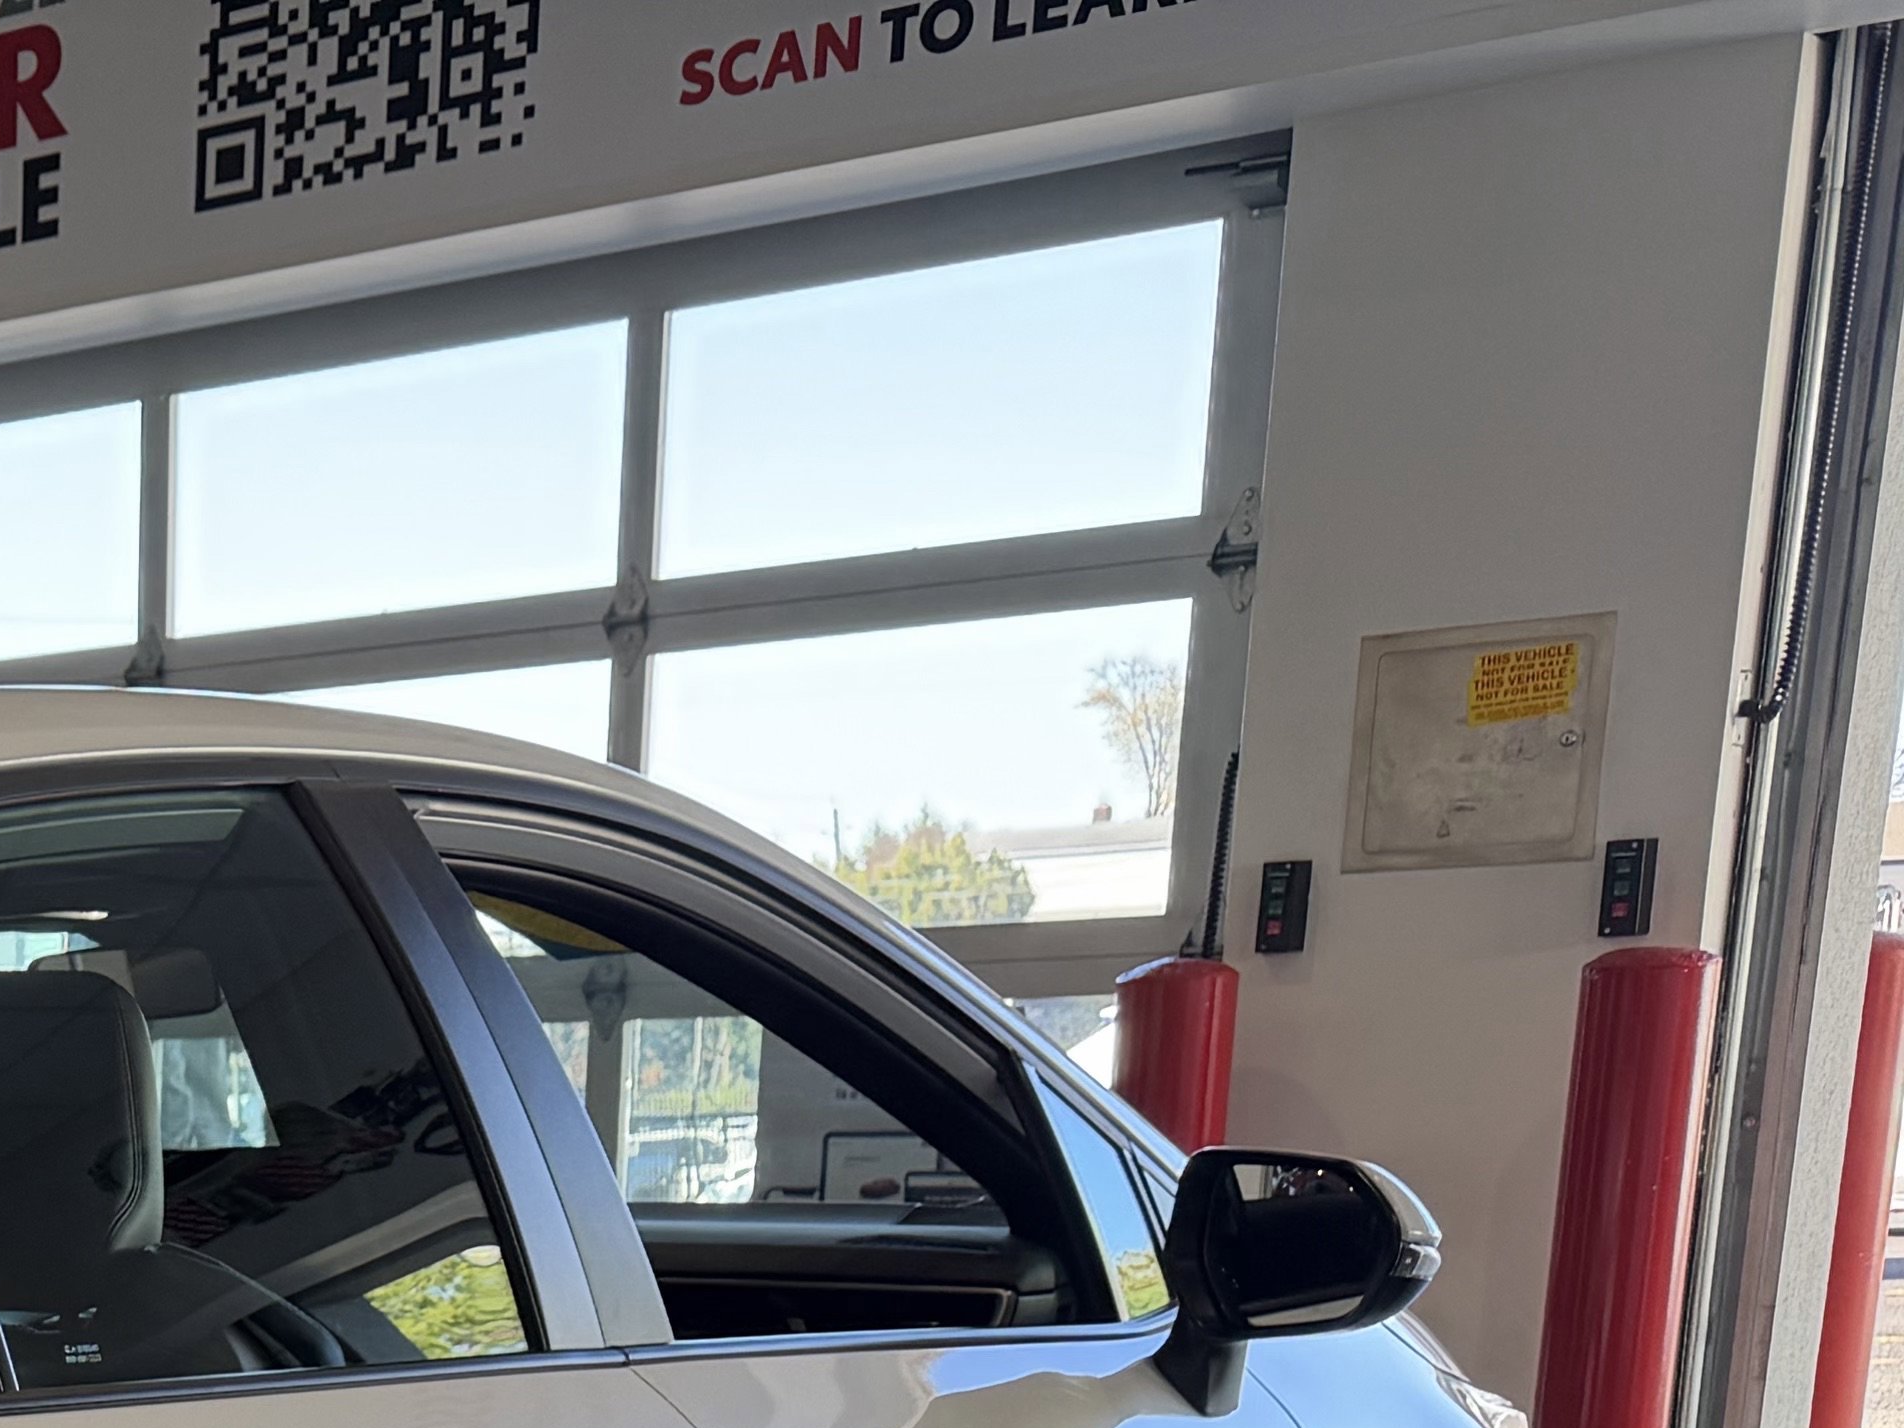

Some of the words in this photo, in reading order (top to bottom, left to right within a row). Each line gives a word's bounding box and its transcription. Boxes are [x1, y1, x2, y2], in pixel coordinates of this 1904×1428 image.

[679, 15, 863, 105] SCAN
[880, 0, 974, 64] TO
[992, 0, 1194, 42] LEA
[1481, 653, 1510, 668] THIS
[1515, 643, 1574, 663] VEHICLE
[1474, 677, 1504, 692] THIS
[1508, 667, 1568, 686] VEHICLE
[1476, 691, 1500, 701] NOT
[1504, 686, 1528, 698] FOR
[1533, 681, 1564, 693] SALE
